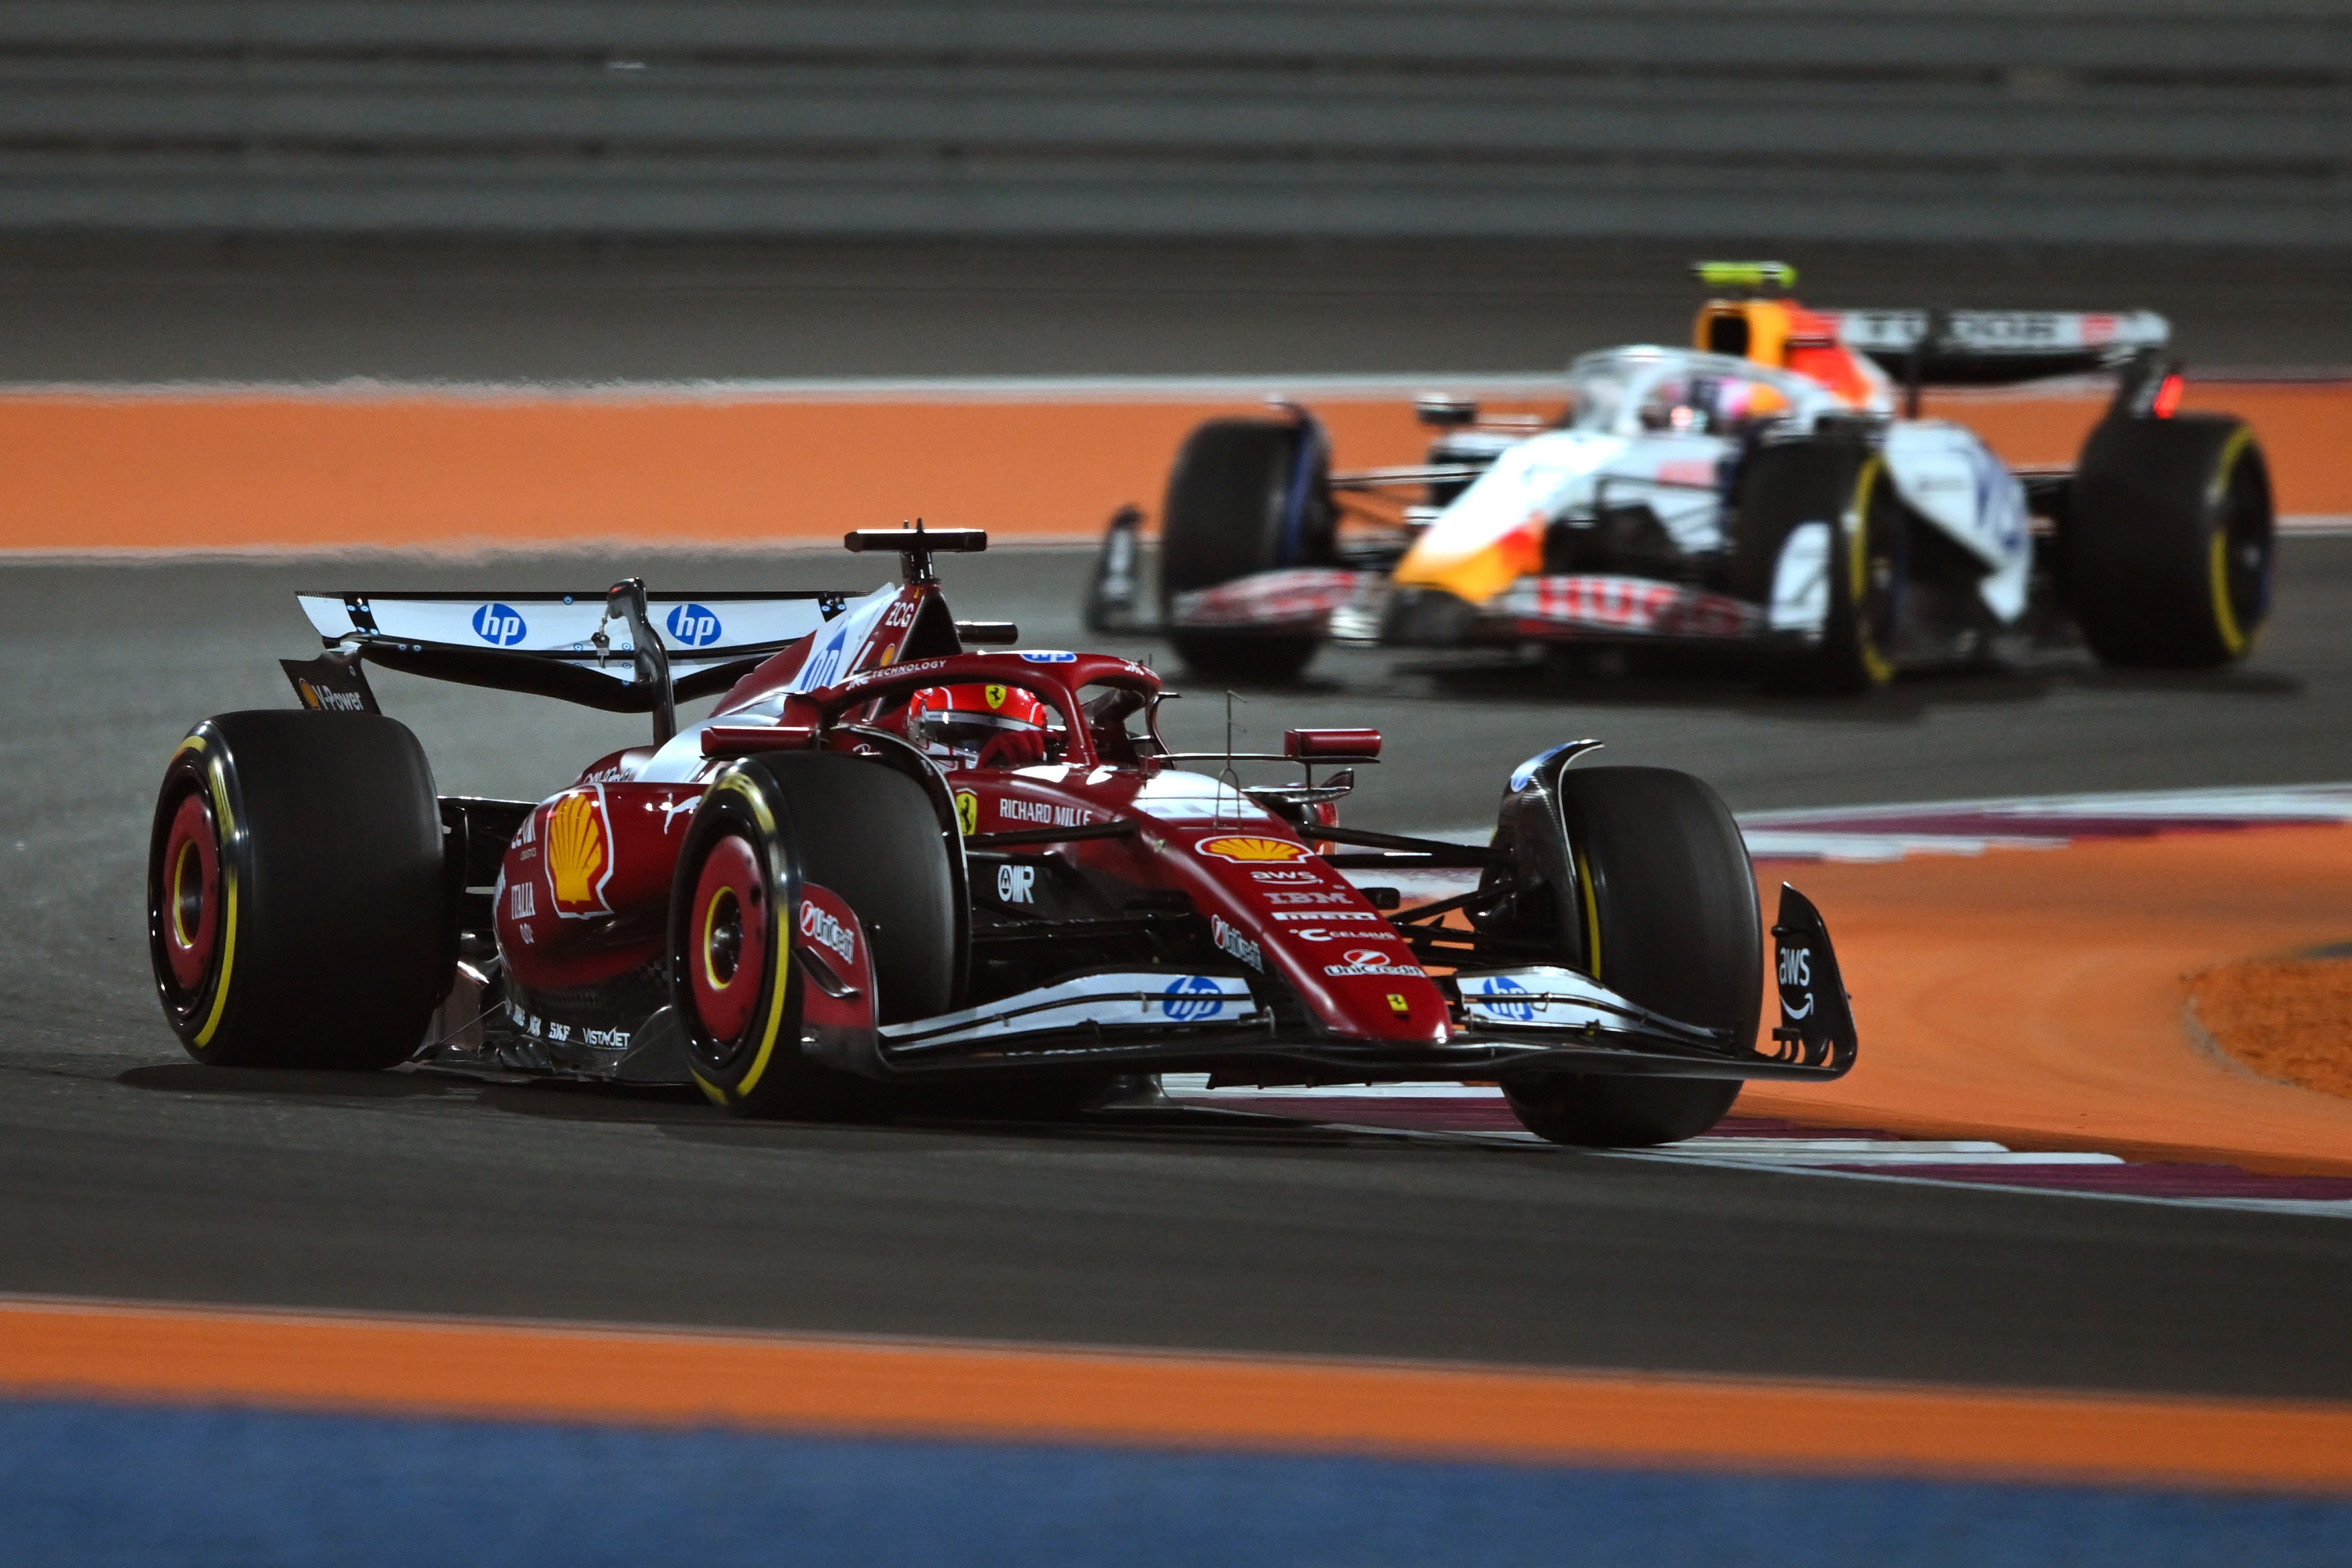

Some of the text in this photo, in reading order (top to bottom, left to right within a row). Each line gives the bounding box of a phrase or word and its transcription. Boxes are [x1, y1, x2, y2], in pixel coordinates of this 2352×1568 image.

[481, 603, 521, 646] hp
[675, 604, 715, 647] hp
[885, 602, 914, 627] ZCG
[873, 660, 947, 678] TECHNOLOGY
[311, 684, 365, 710] V-Power
[1000, 798, 1093, 827] RICHARD MILLE
[1250, 871, 1319, 880] aws
[1263, 891, 1355, 904] IBM
[1272, 911, 1378, 921] PIRELLI
[1330, 931, 1396, 941] CELSIUS
[1324, 964, 1428, 978] UniCredit
[1779, 947, 1810, 987] aws
[1168, 976, 1220, 1021] hp
[1489, 976, 1529, 1021] hp
[549, 1022, 572, 1042] SKF
